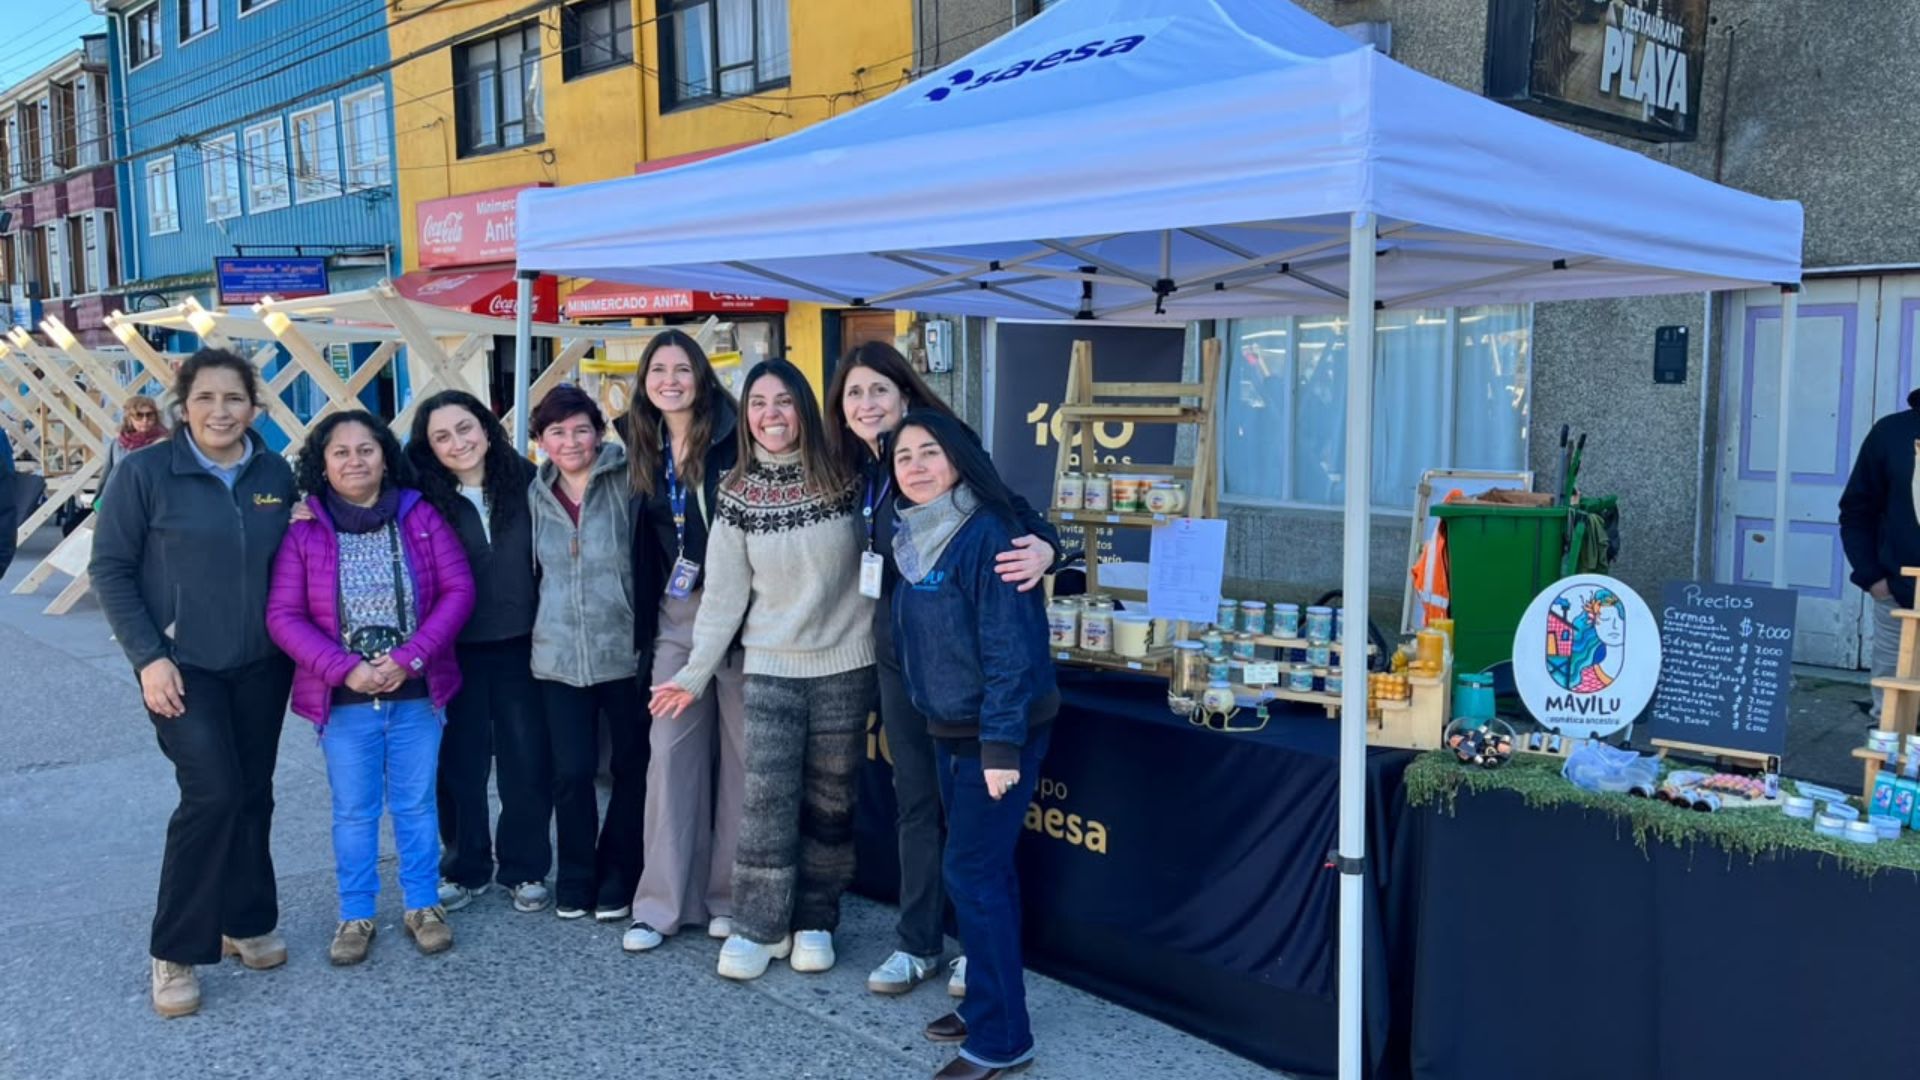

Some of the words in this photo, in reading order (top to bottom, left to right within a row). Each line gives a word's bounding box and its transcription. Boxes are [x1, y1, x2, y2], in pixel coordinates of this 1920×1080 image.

[1622, 4, 1685, 47] RESTAURANT
[963, 35, 1146, 91] saesa
[1600, 25, 1688, 115] PLAYA
[567, 296, 647, 313] MINIMERCADO
[653, 293, 690, 309] ANITA
[1683, 584, 1754, 609] Precios
[1663, 607, 1715, 624] Cremas
[1545, 693, 1621, 715] MAVILU
